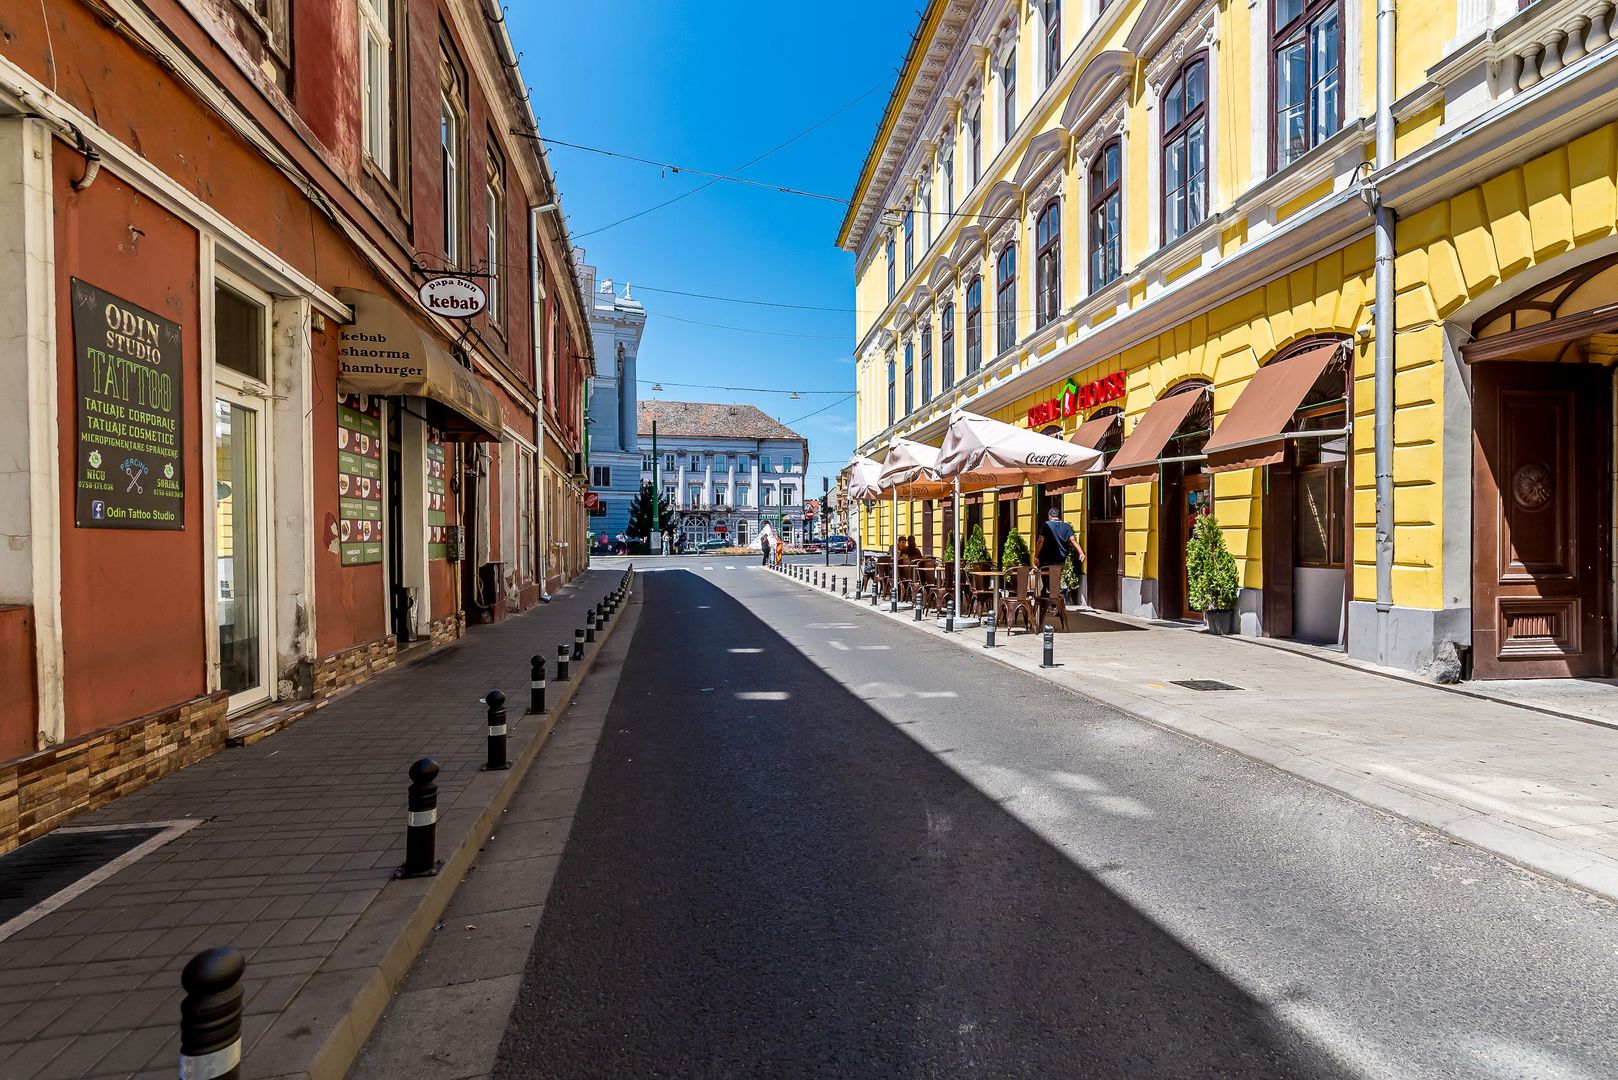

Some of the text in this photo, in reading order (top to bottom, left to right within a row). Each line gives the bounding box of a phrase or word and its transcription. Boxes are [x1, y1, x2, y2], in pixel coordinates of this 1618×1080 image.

[428, 279, 477, 293] papa bun
[429, 294, 479, 310] kebab
[105, 303, 160, 348] ODIN
[340, 332, 386, 343] kebab
[106, 331, 161, 365] STUDIO
[341, 347, 410, 360] shaorma
[342, 362, 424, 378] hamburger
[87, 347, 172, 412] TATTOO
[1078, 370, 1127, 410] HOUSE
[84, 397, 176, 432] TATUAJE CORPORALE
[87, 416, 174, 446] TATUAJE COSMETICE
[81, 432, 145, 452] MICROPIGMENTARE
[86, 469, 106, 480] NICU
[120, 458, 149, 475] PIERCING
[107, 506, 126, 518] Odin
[128, 508, 151, 519] Tattoo
[153, 510, 175, 520] Studio
